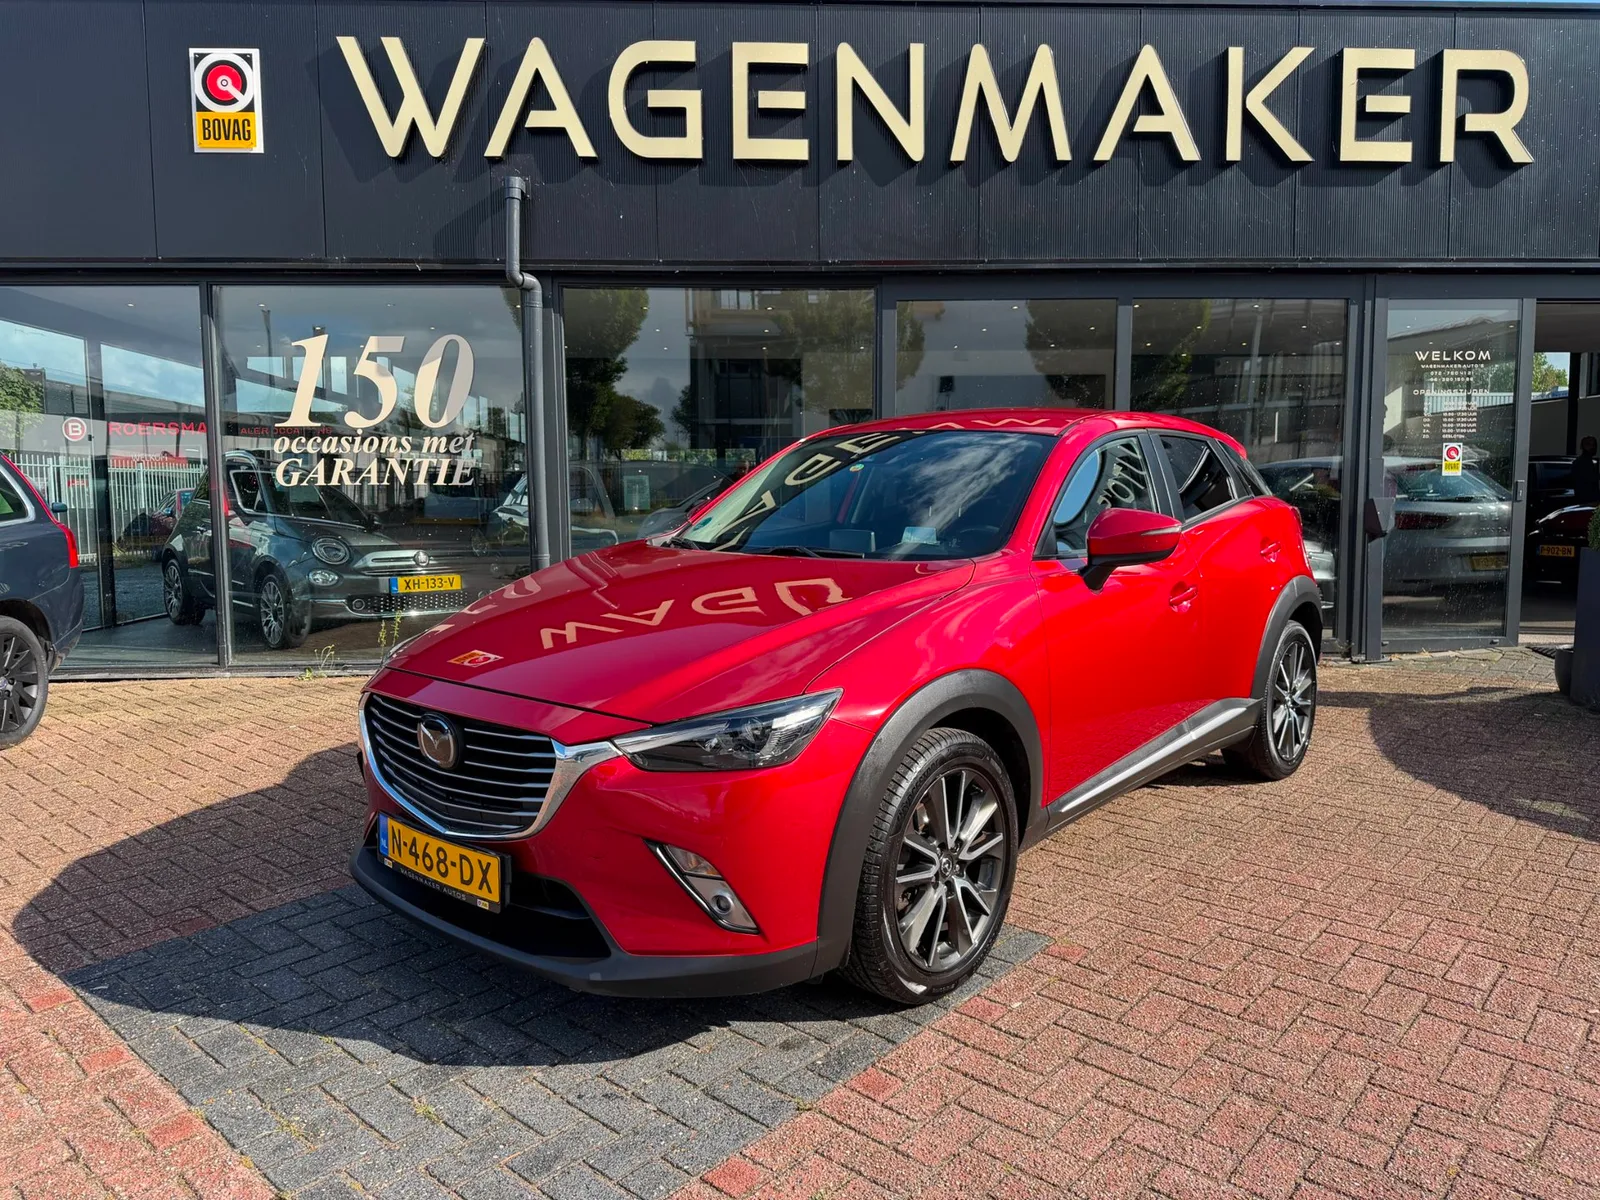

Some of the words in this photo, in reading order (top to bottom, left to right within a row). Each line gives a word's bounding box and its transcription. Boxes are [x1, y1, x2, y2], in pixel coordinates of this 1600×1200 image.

[336, 36, 1534, 163] WAGENMAKER
[202, 118, 252, 141] BOVAG
[1414, 350, 1491, 361] WELKOM
[274, 333, 475, 429] 150
[108, 422, 208, 436] ROERSMA
[273, 428, 413, 454] occasions
[422, 432, 476, 454] met
[275, 458, 476, 487] GARANTIE
[403, 577, 455, 590] XH-133-V
[391, 825, 493, 894] N-468-DX
